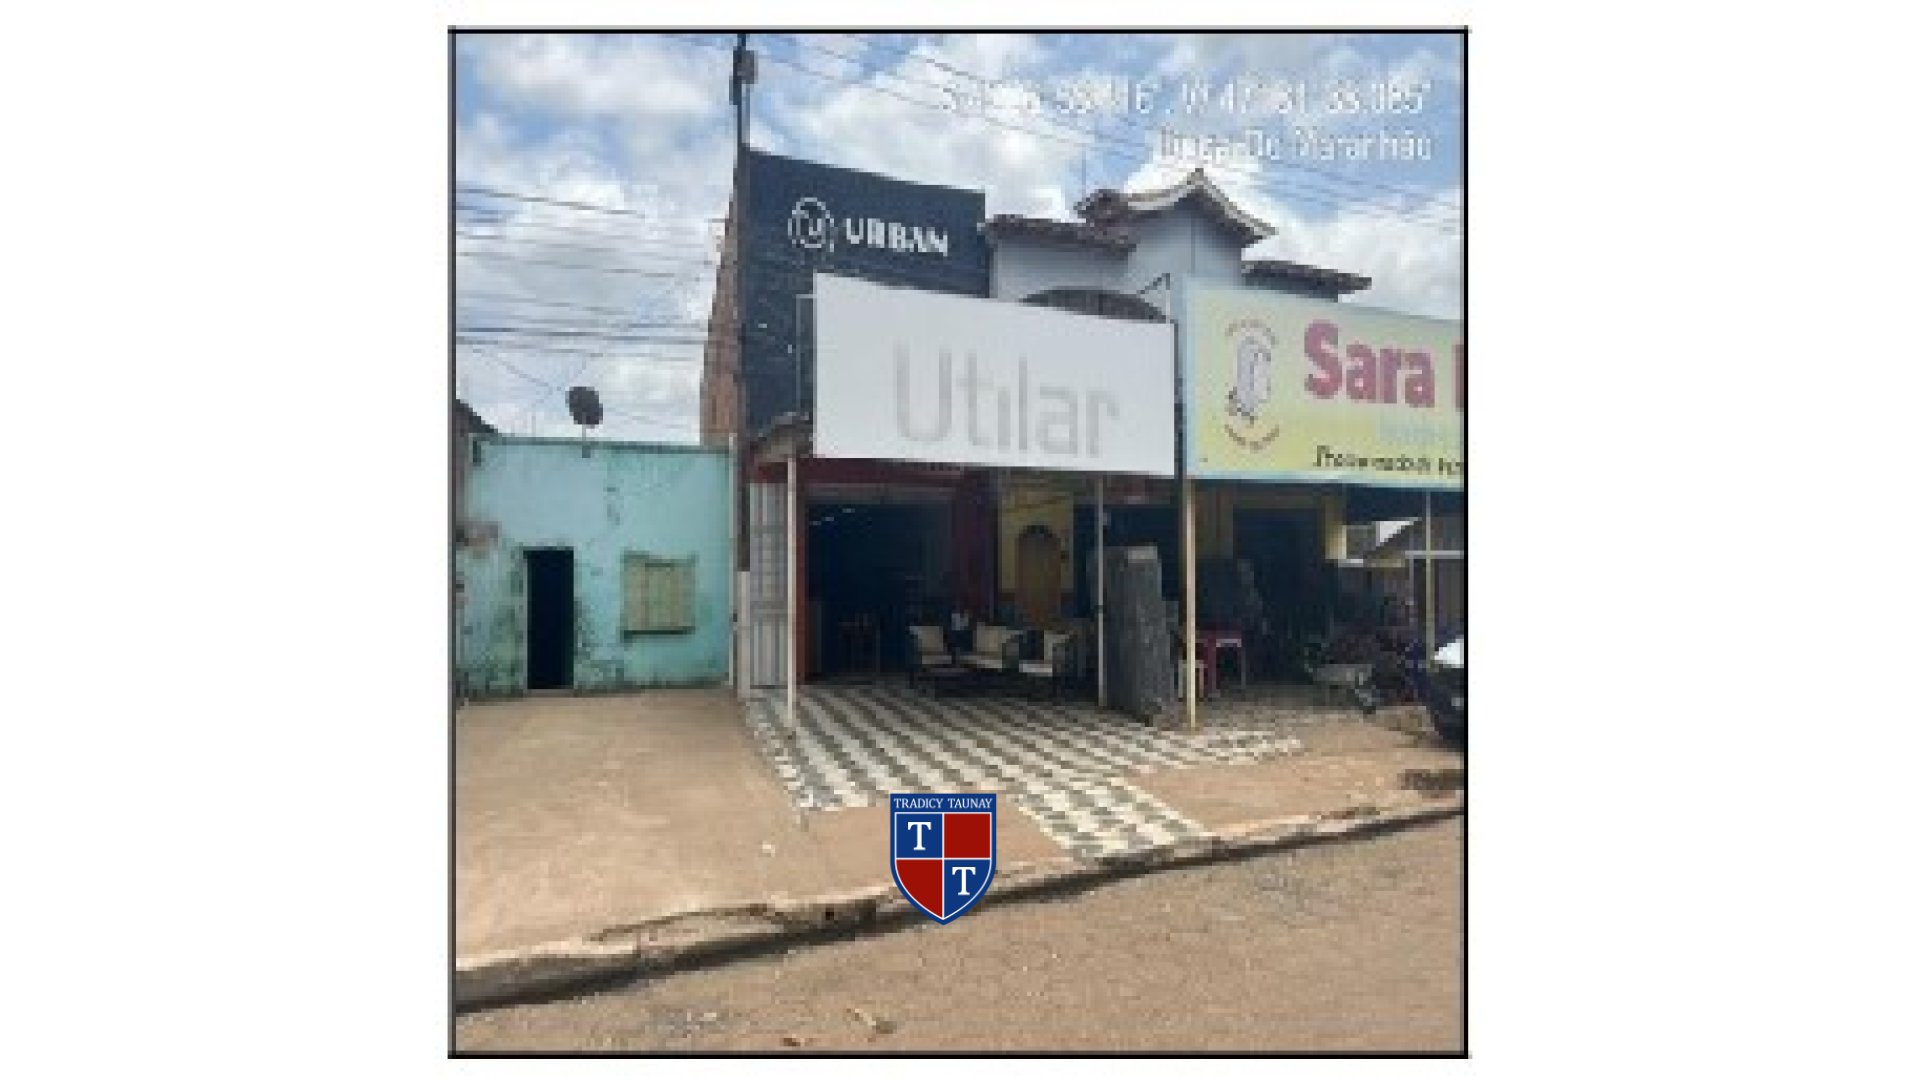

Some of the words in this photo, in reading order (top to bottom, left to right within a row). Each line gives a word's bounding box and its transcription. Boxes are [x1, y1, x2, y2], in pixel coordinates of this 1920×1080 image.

[845, 217, 949, 257] URBAN
[894, 344, 1121, 459] Utilar
[1304, 317, 1436, 409] Sara
